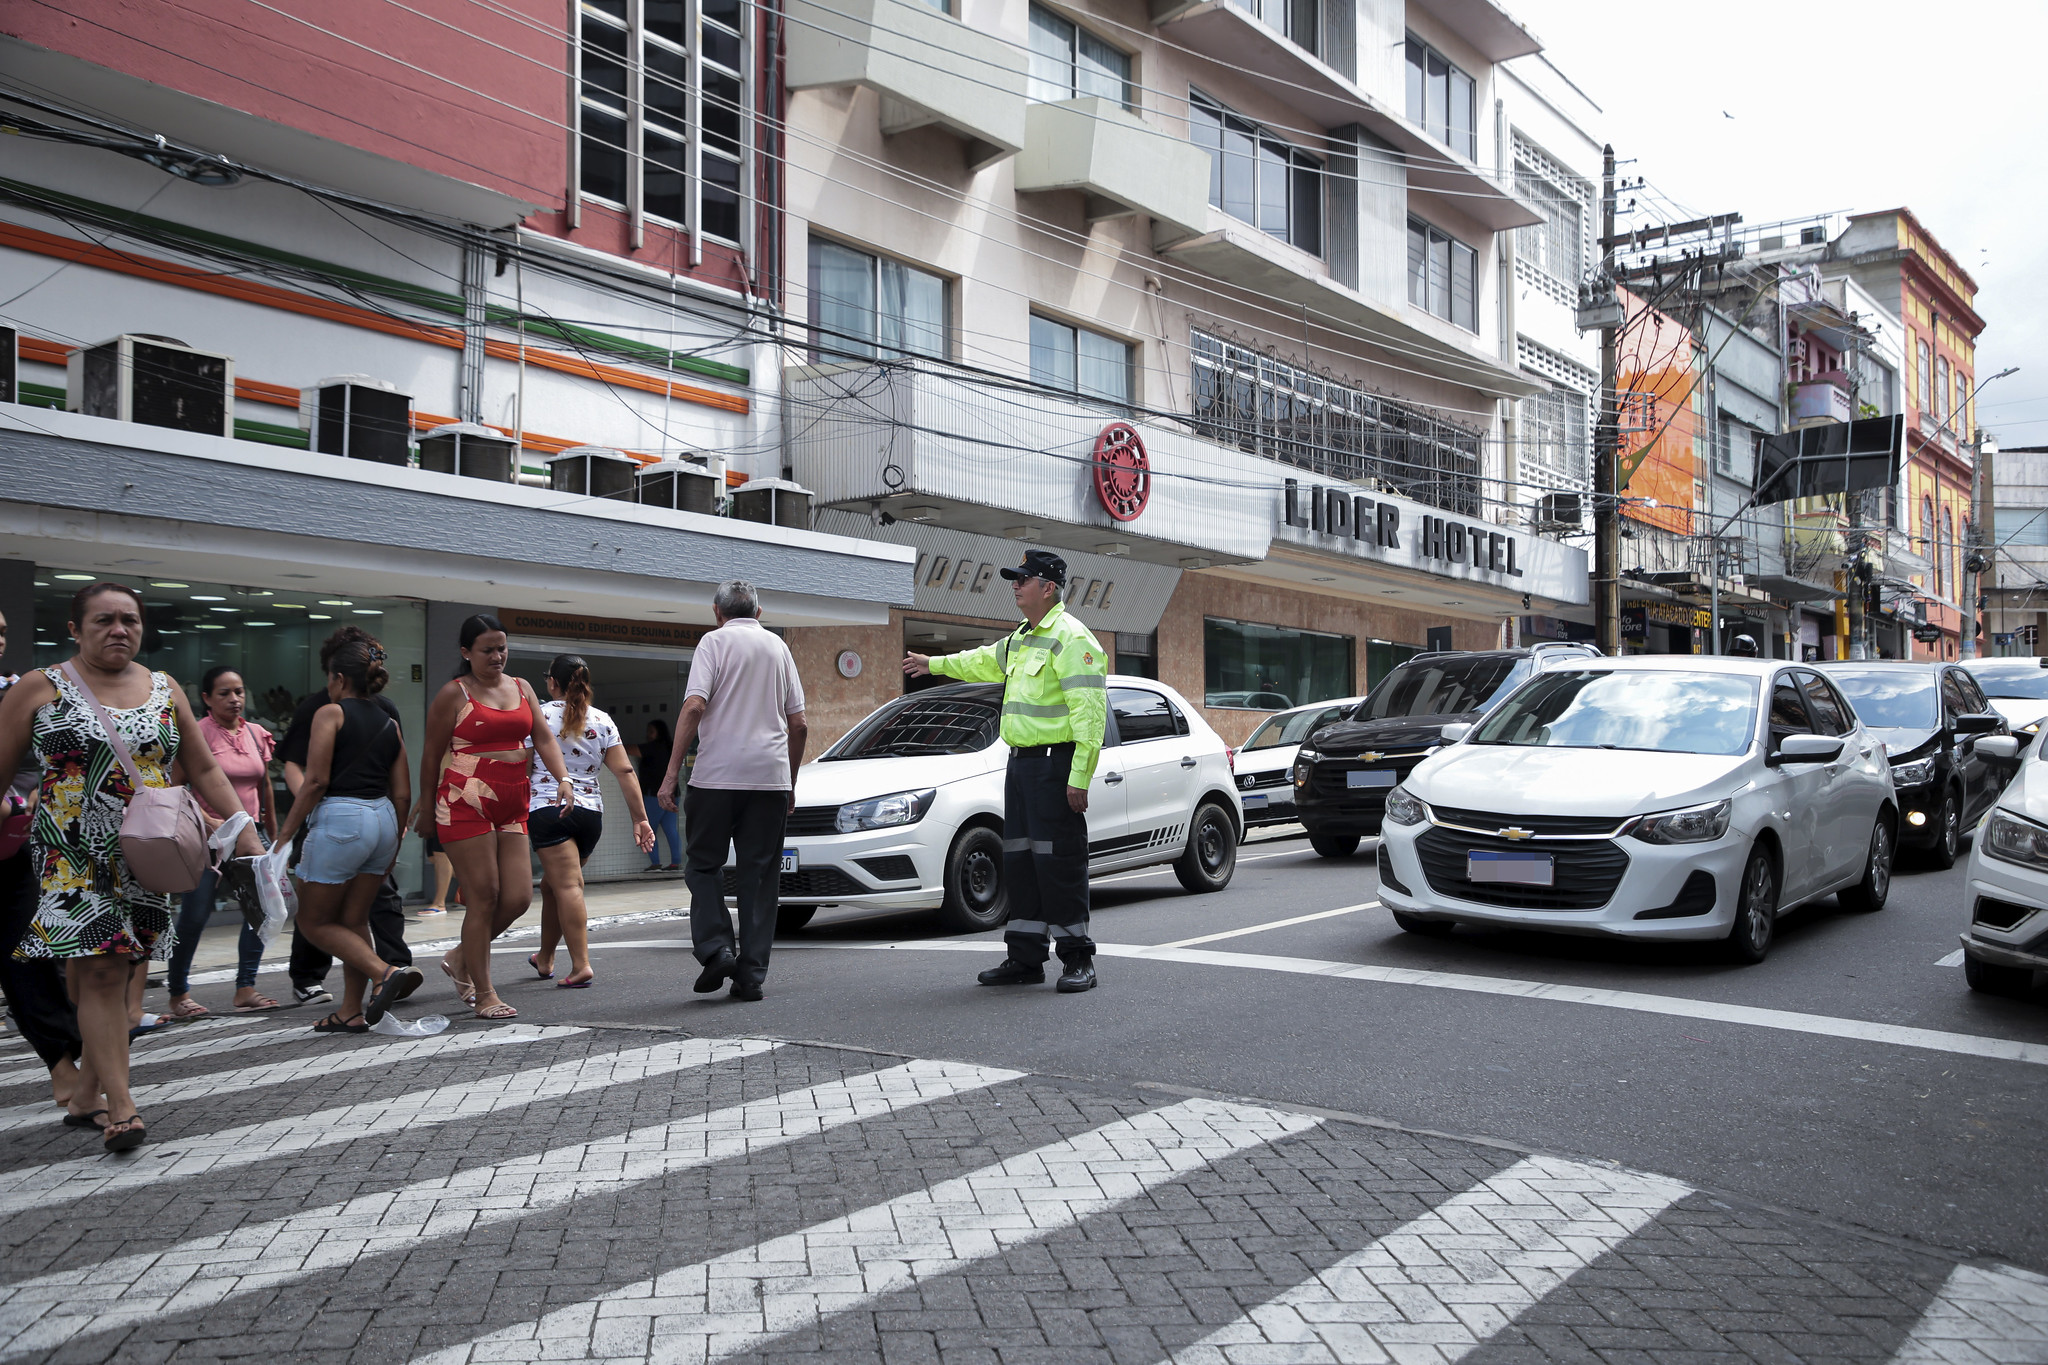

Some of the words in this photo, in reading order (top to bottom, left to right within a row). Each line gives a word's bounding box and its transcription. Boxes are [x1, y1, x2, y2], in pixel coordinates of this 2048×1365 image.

[1103, 481, 1147, 514] HOTEL
[1285, 478, 1400, 549] LIDER
[1423, 514, 1523, 577] HOTEL
[914, 553, 995, 595] IDER
[1065, 576, 1115, 610] TEL
[515, 616, 586, 632] CONDOMÍNIO
[588, 621, 628, 635] EDIFÍCIO
[631, 626, 672, 639] ESQUINA
[674, 629, 691, 639] DAS
[1621, 624, 1642, 632] tore
